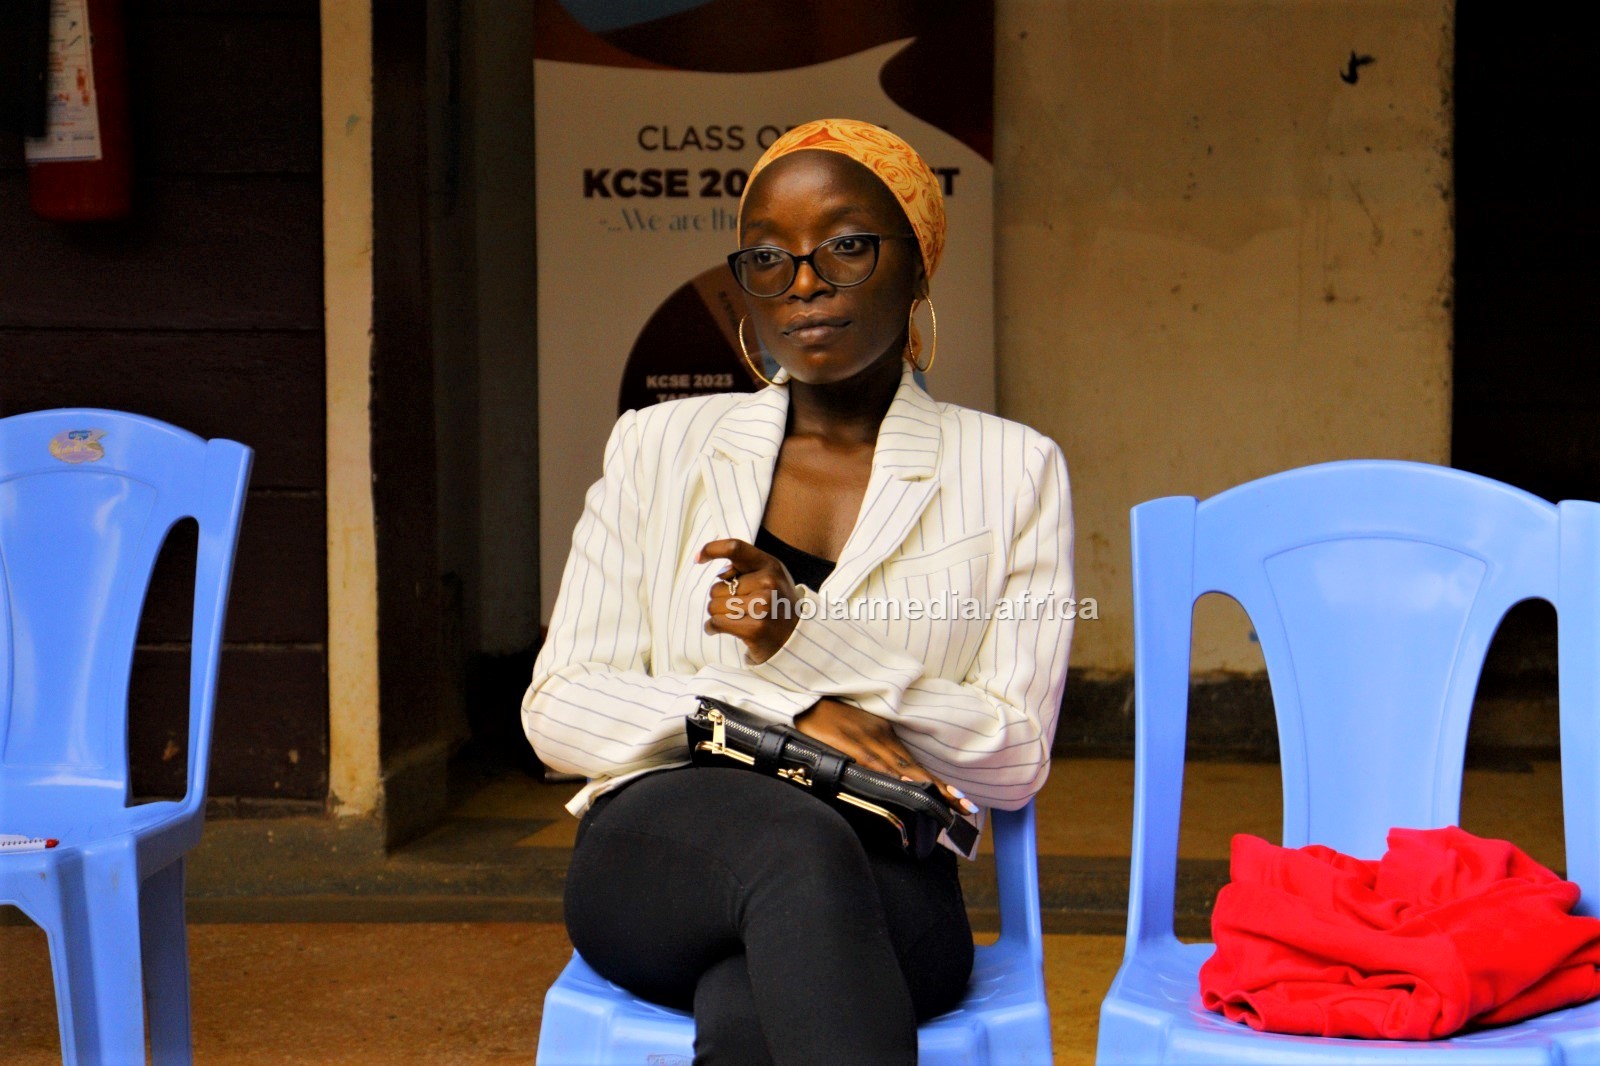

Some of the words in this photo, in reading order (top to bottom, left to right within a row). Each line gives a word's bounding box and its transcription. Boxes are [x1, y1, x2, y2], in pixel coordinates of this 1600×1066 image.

[637, 125, 746, 152] CLASS
[756, 125, 794, 152] O
[583, 168, 689, 198] KCSE
[699, 167, 747, 198] 20
[668, 215, 702, 232] are
[711, 207, 738, 231] th
[646, 374, 690, 389] KCSE
[693, 374, 734, 388] 2023
